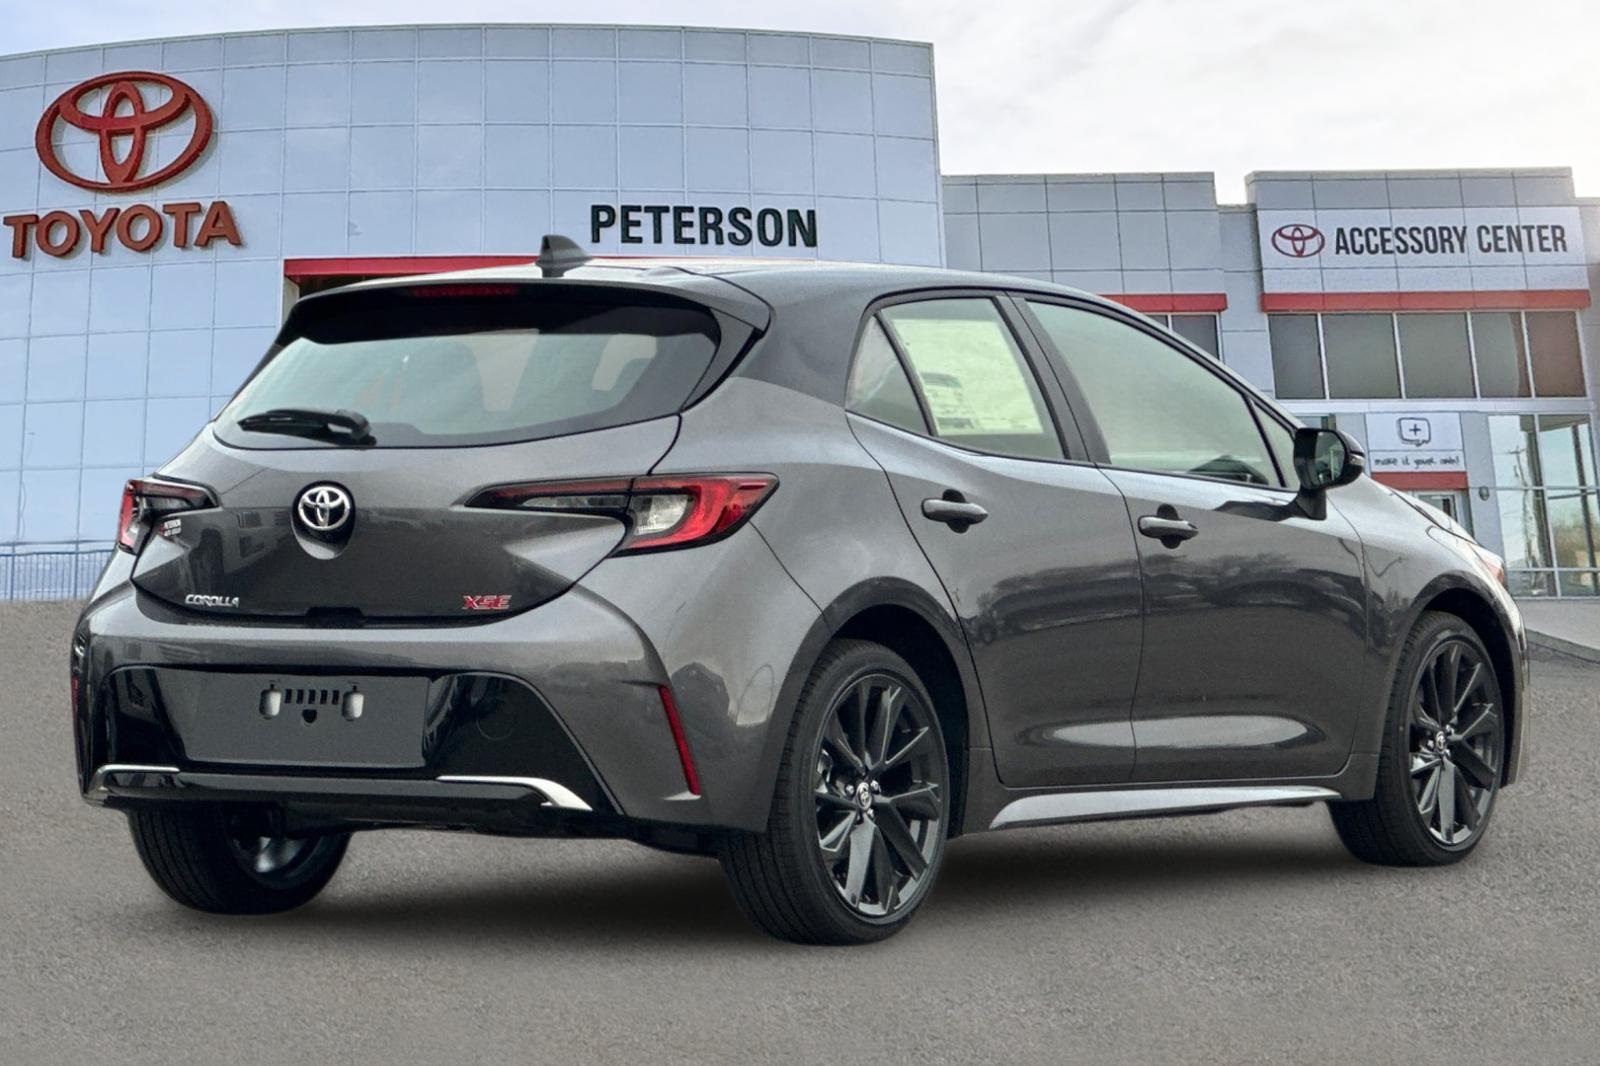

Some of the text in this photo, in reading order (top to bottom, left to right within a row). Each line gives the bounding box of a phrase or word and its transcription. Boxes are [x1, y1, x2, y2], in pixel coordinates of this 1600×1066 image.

[3, 201, 241, 258] TOYOTA
[591, 204, 817, 247] PETERSON
[1335, 224, 1568, 255] ACCESSORY CENTER
[1374, 456, 1398, 466] make
[1402, 455, 1410, 466] it
[1414, 456, 1436, 470] your
[185, 593, 239, 608] COROLLA
[462, 594, 512, 610] XSE
